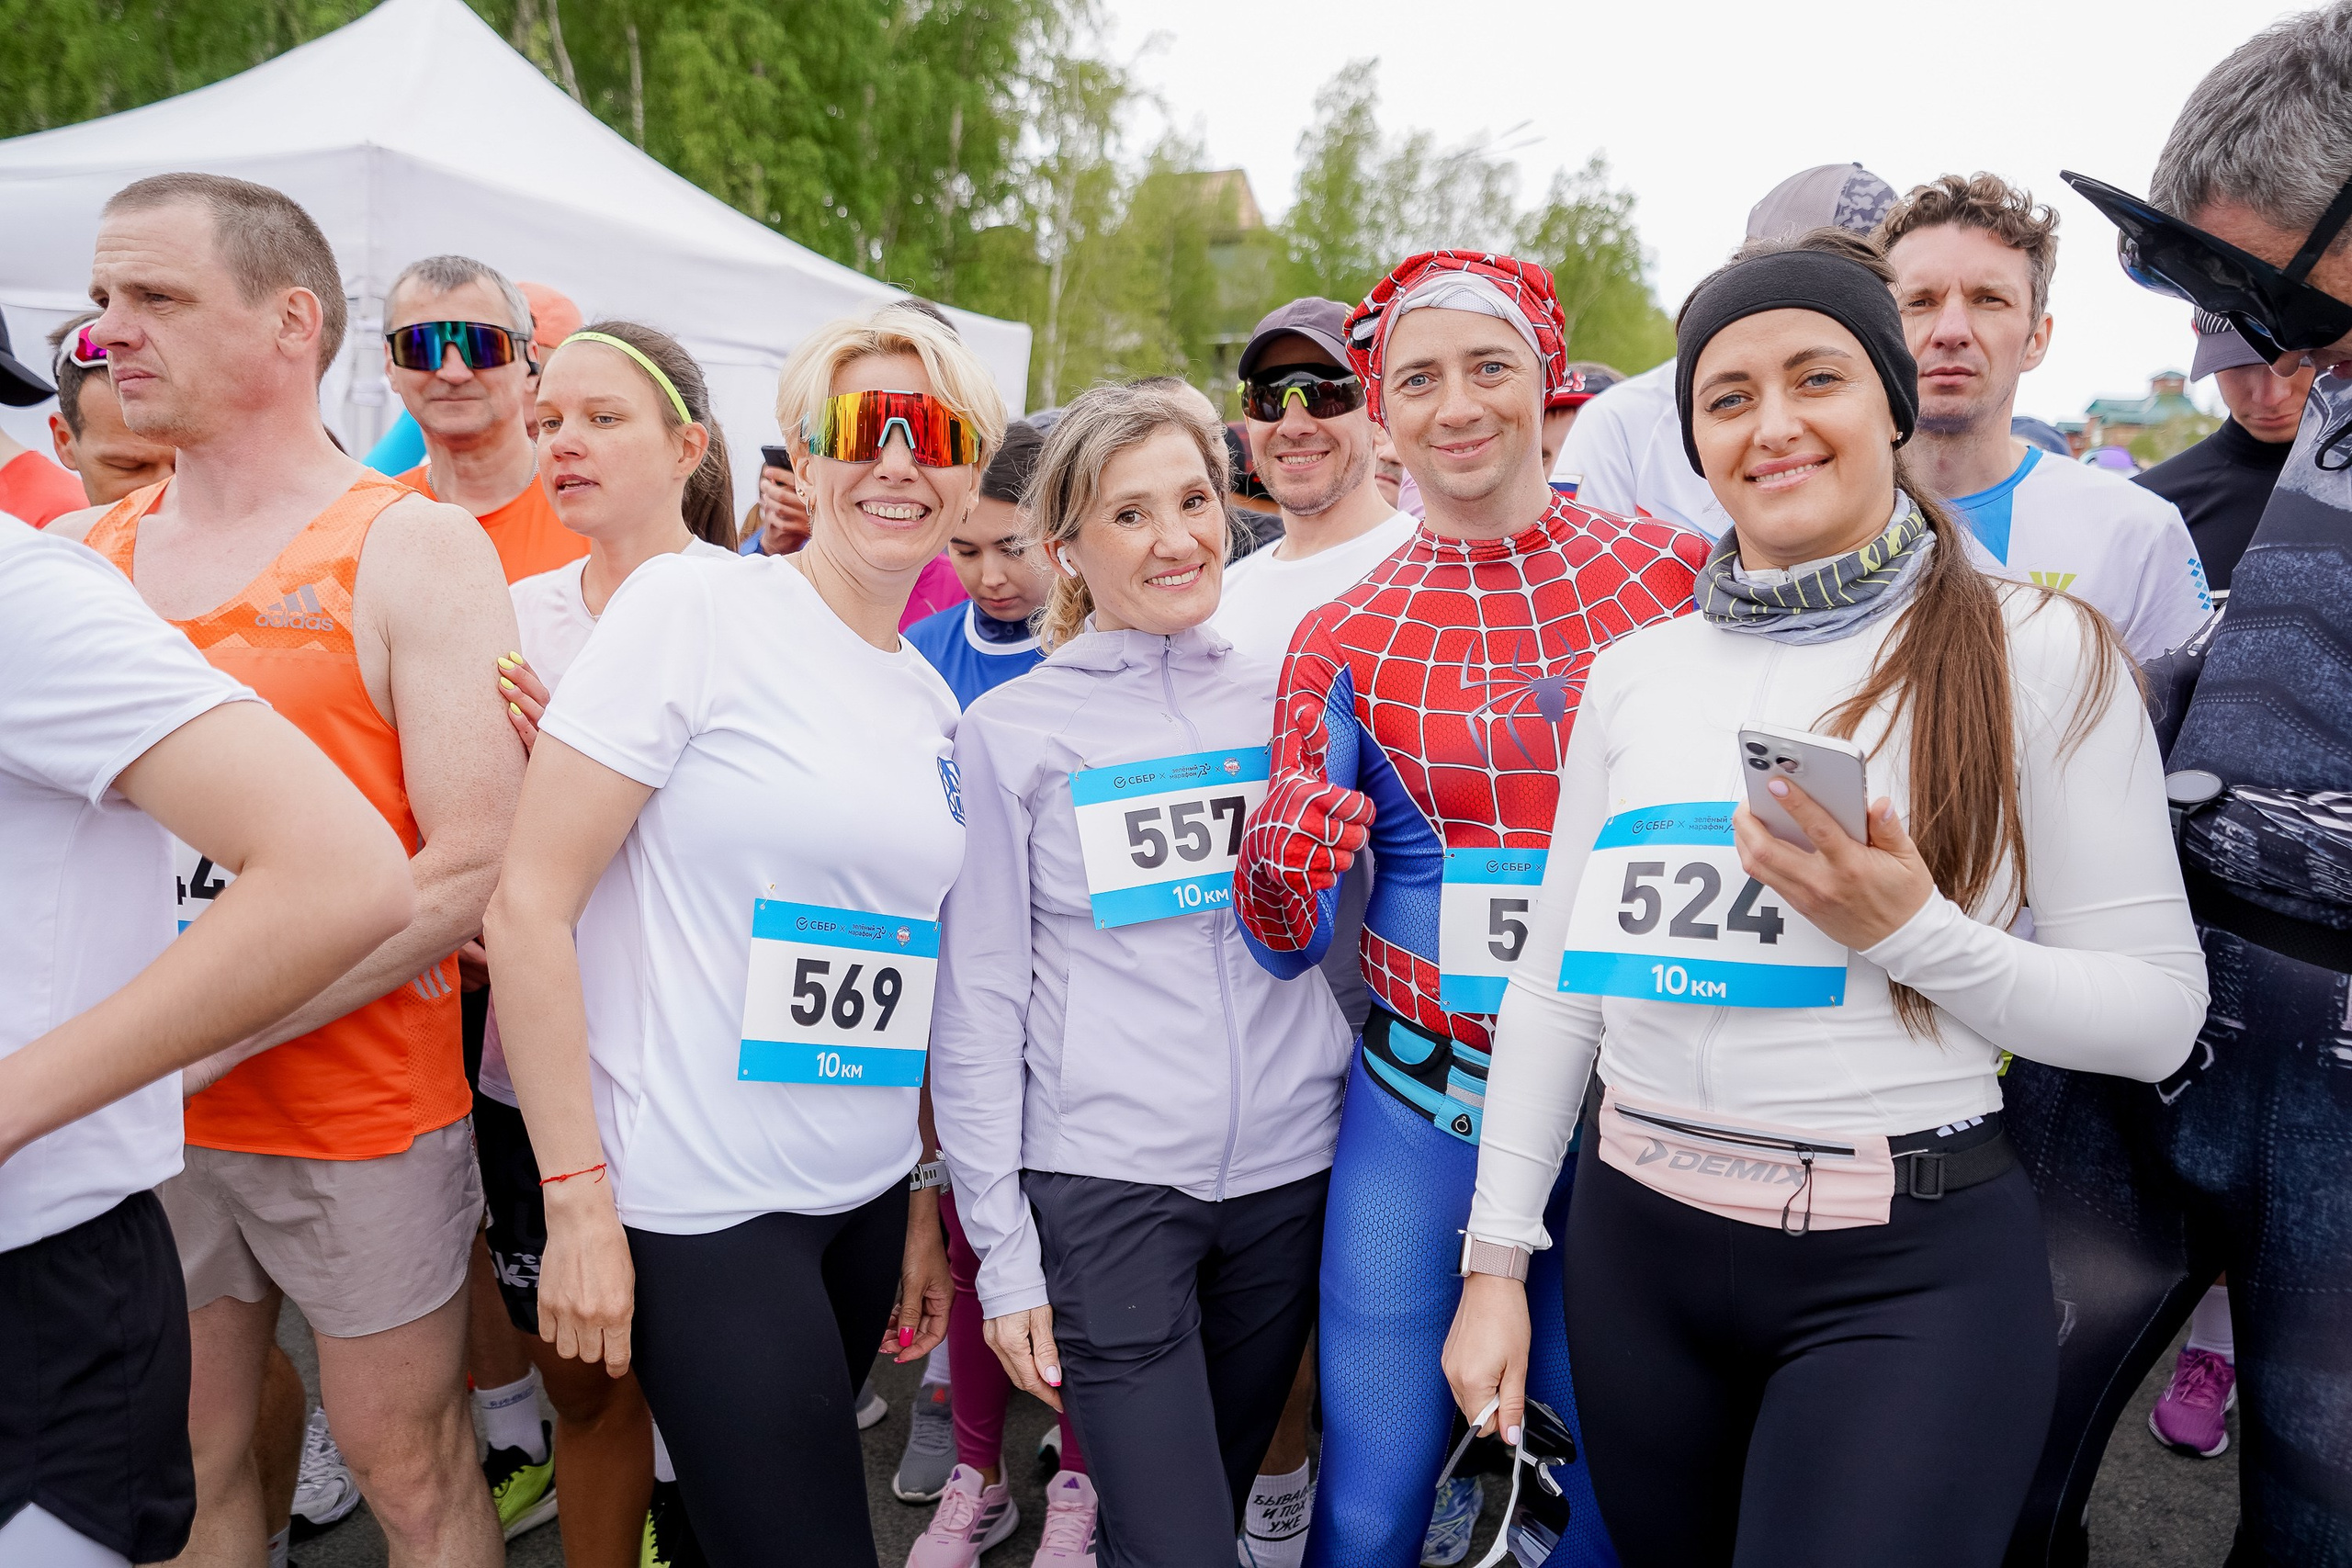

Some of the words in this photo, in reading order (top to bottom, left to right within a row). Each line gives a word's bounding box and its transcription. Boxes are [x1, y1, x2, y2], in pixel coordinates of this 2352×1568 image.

[254, 611, 334, 632] adidas
[1128, 773, 1156, 784] СБЕР
[1125, 795, 1247, 870] 557
[1645, 819, 1674, 830] СБЕР
[1501, 862, 1532, 872] СБЕР
[1618, 862, 1784, 945] 524
[810, 920, 837, 932] СБЕР
[790, 958, 902, 1032] 569
[1668, 1150, 1816, 1188] DEMIX
[1261, 1507, 1278, 1519] И
[1268, 1514, 1303, 1533] УЖЕ
